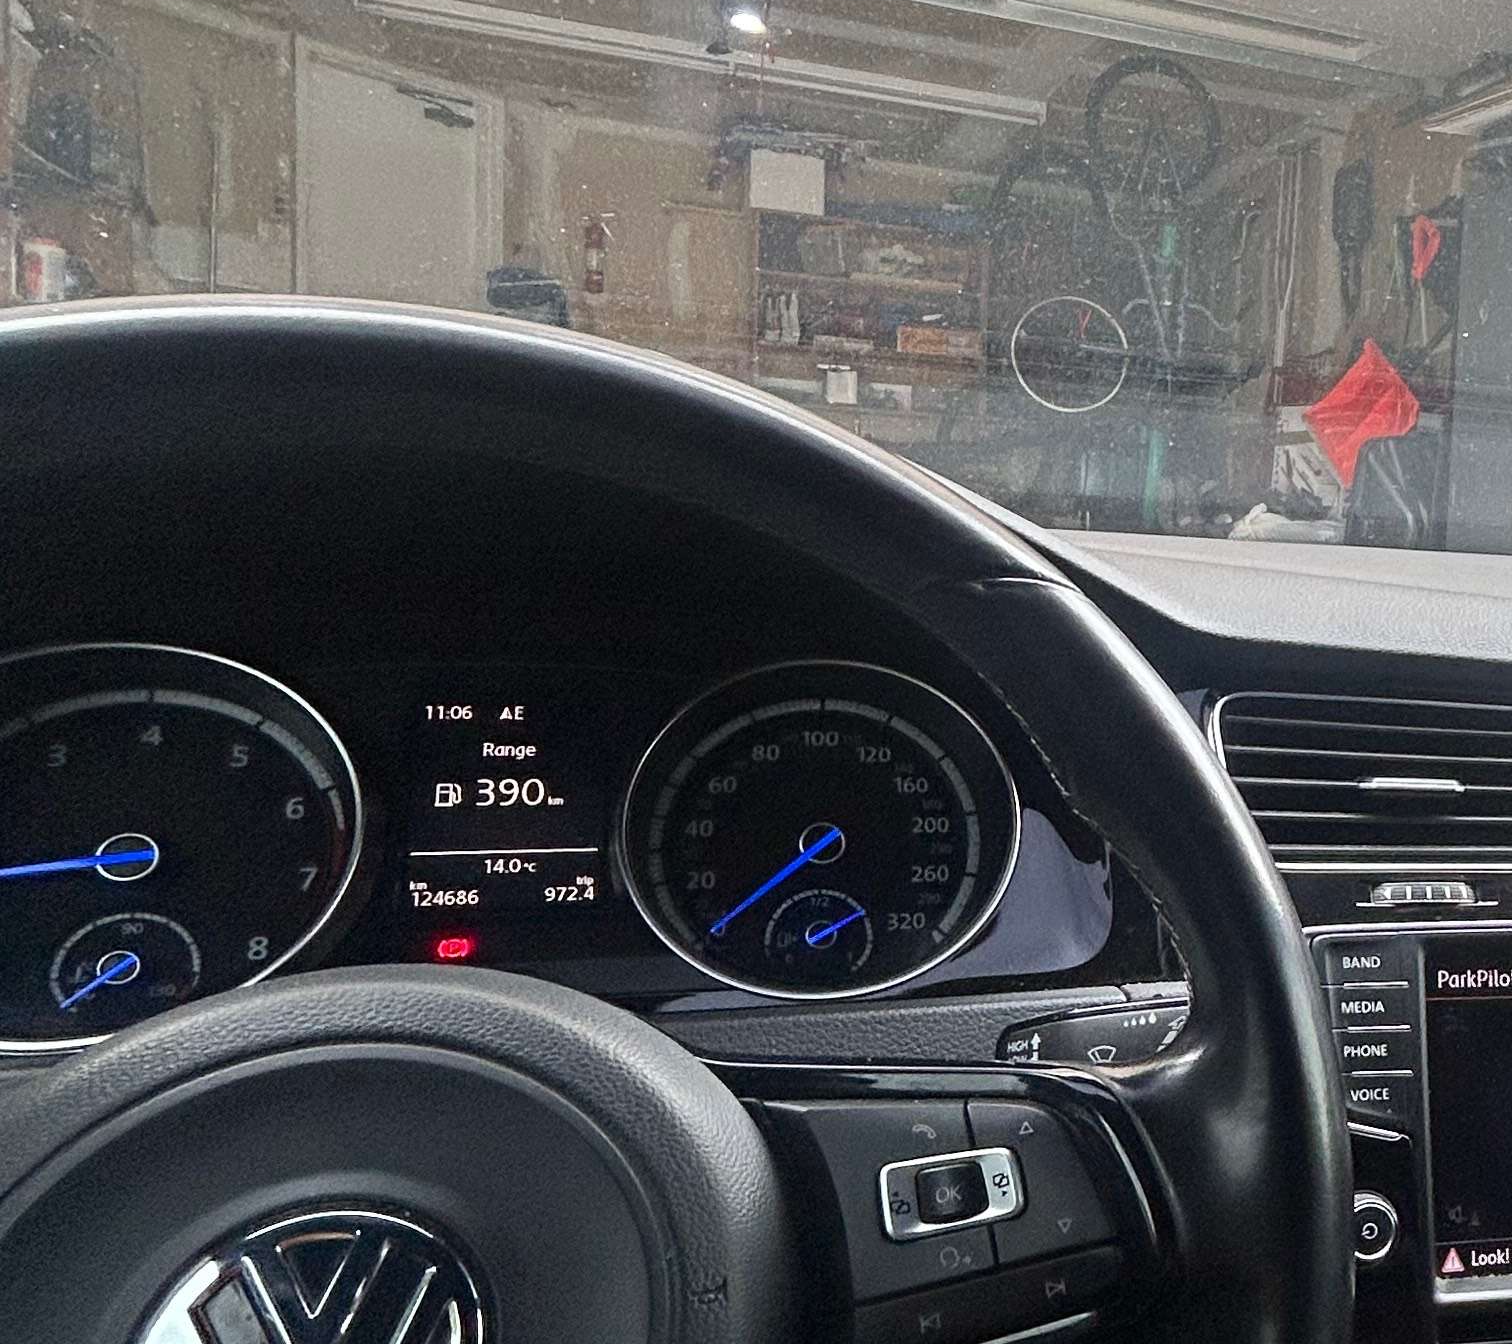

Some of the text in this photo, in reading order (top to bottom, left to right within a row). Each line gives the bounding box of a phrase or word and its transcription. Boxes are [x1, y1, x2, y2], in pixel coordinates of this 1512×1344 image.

[425, 705, 473, 720] 11:06
[139, 725, 164, 747] 4
[802, 730, 840, 748] 100
[48, 744, 67, 768] 3
[230, 744, 250, 768] 5
[482, 742, 537, 760] Range
[751, 744, 780, 761] 80
[857, 746, 892, 763] 120
[475, 778, 545, 807] 390
[708, 776, 738, 794] 60
[892, 776, 929, 794] 160
[285, 797, 305, 820] 6
[684, 819, 714, 838] 40
[911, 816, 950, 834] 200
[300, 866, 318, 892] 7
[576, 875, 594, 886] trip
[686, 870, 716, 890] 20
[911, 864, 950, 883] 260
[409, 880, 427, 890] km
[544, 886, 594, 902] 972.4
[411, 889, 479, 907] 124686
[887, 912, 926, 931] 320
[248, 936, 270, 961] 8
[1342, 956, 1381, 969] BAND
[1341, 1000, 1385, 1014] MEDIA
[1007, 1039, 1029, 1053] HIGH
[1343, 1044, 1388, 1057] PHONE
[1350, 1088, 1390, 1102] VOICE
[935, 1184, 962, 1204] OK
[1471, 1248, 1510, 1267] Look!
